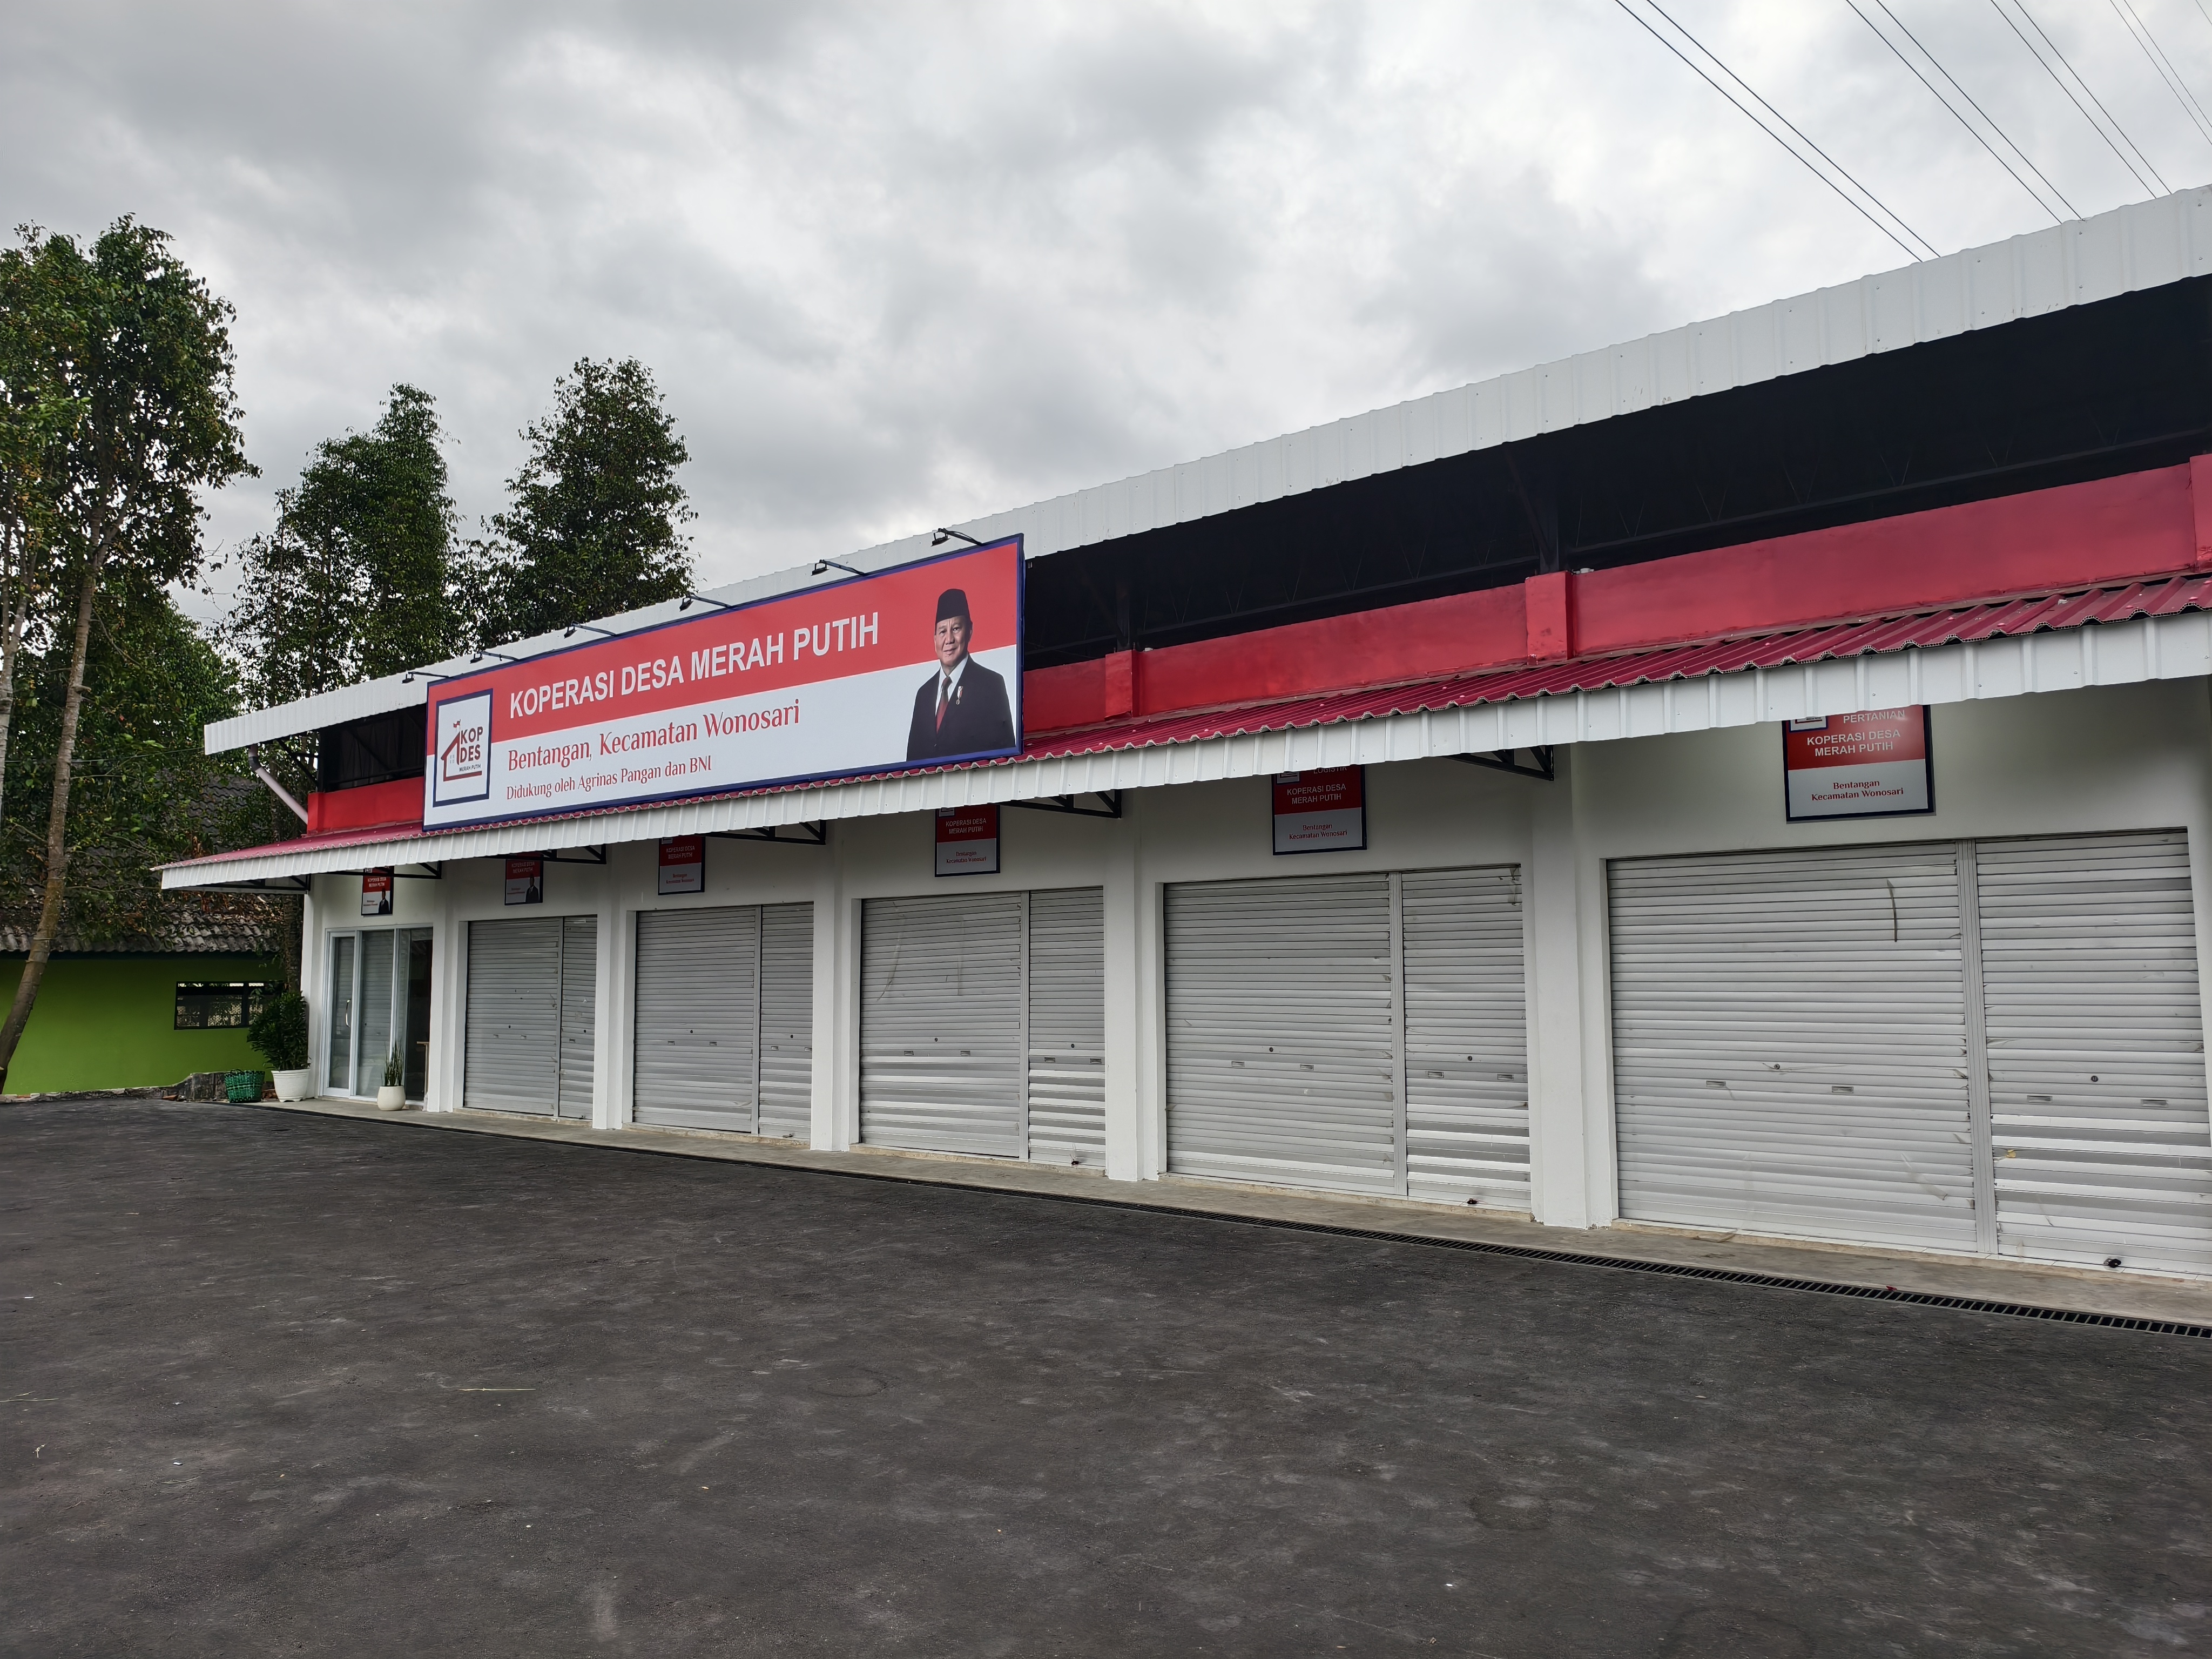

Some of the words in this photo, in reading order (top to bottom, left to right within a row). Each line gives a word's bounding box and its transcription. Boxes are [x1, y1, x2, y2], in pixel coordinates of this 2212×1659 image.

[510, 670, 614, 719] KOPERASI
[622, 656, 684, 695] DESA
[691, 632, 784, 682] MERAH
[794, 611, 878, 660] PUTIH
[1843, 710, 1905, 724] PERTANIAN
[461, 726, 483, 744] KOP
[508, 741, 592, 771] Bentangan,
[599, 721, 698, 756] Kecamatan
[703, 699, 799, 738] Wonosari
[1807, 732, 1865, 746] KOPERASI
[1869, 729, 1900, 740] DESA
[460, 745, 481, 763] DES
[1815, 745, 1856, 757] MERAH
[1859, 741, 1893, 753] PUTIH
[507, 783, 552, 800] Didukung
[555, 777, 575, 793] oleh
[578, 772, 618, 792] Agrinas
[621, 765, 661, 784] Pangan
[665, 761, 686, 777] dan
[690, 755, 712, 773] BNI
[1833, 780, 1880, 790] Bentangan
[1287, 785, 1324, 795] KOPERASI
[1326, 783, 1346, 792] DESA
[1811, 791, 1859, 801] Kecamatan
[1861, 787, 1904, 798] Wonosari
[1292, 795, 1318, 805] MERAH
[1320, 793, 1341, 802] PUTIH
[946, 819, 972, 827] KOPERASI
